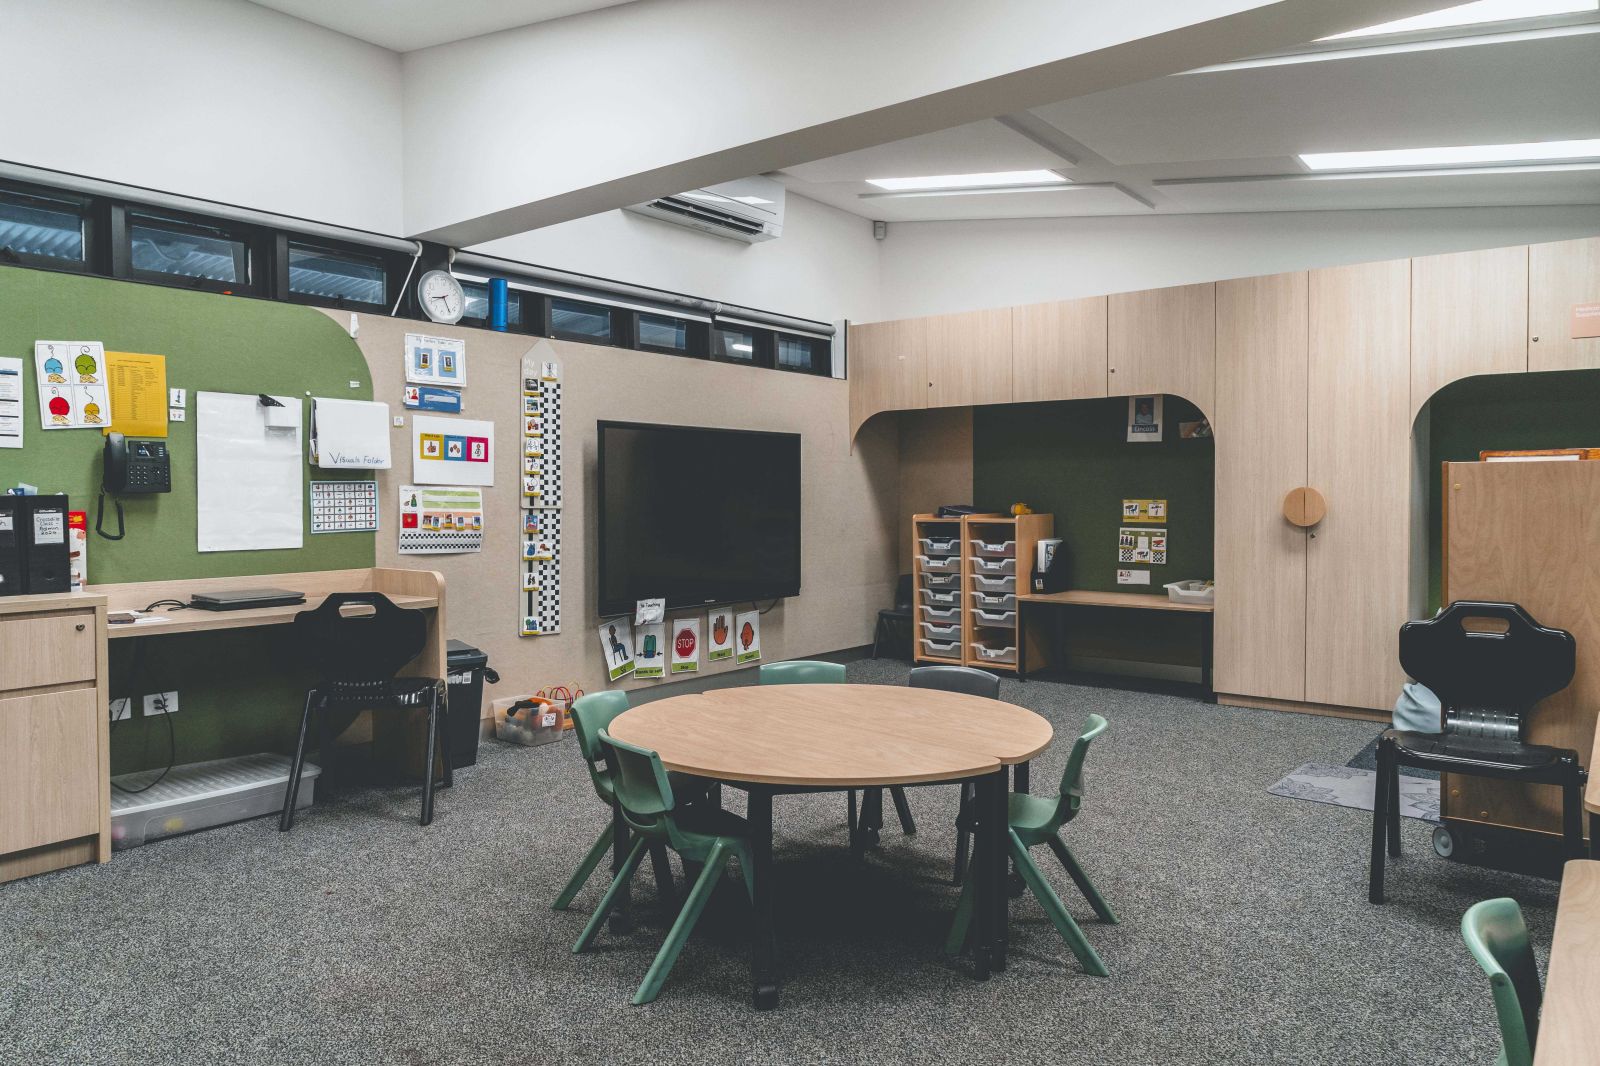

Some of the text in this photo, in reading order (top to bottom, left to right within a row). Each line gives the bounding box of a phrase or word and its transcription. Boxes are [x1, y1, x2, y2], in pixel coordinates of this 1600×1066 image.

[524, 358, 535, 368] My
[328, 452, 385, 465] Visuals Folder
[677, 637, 694, 649] STOP
